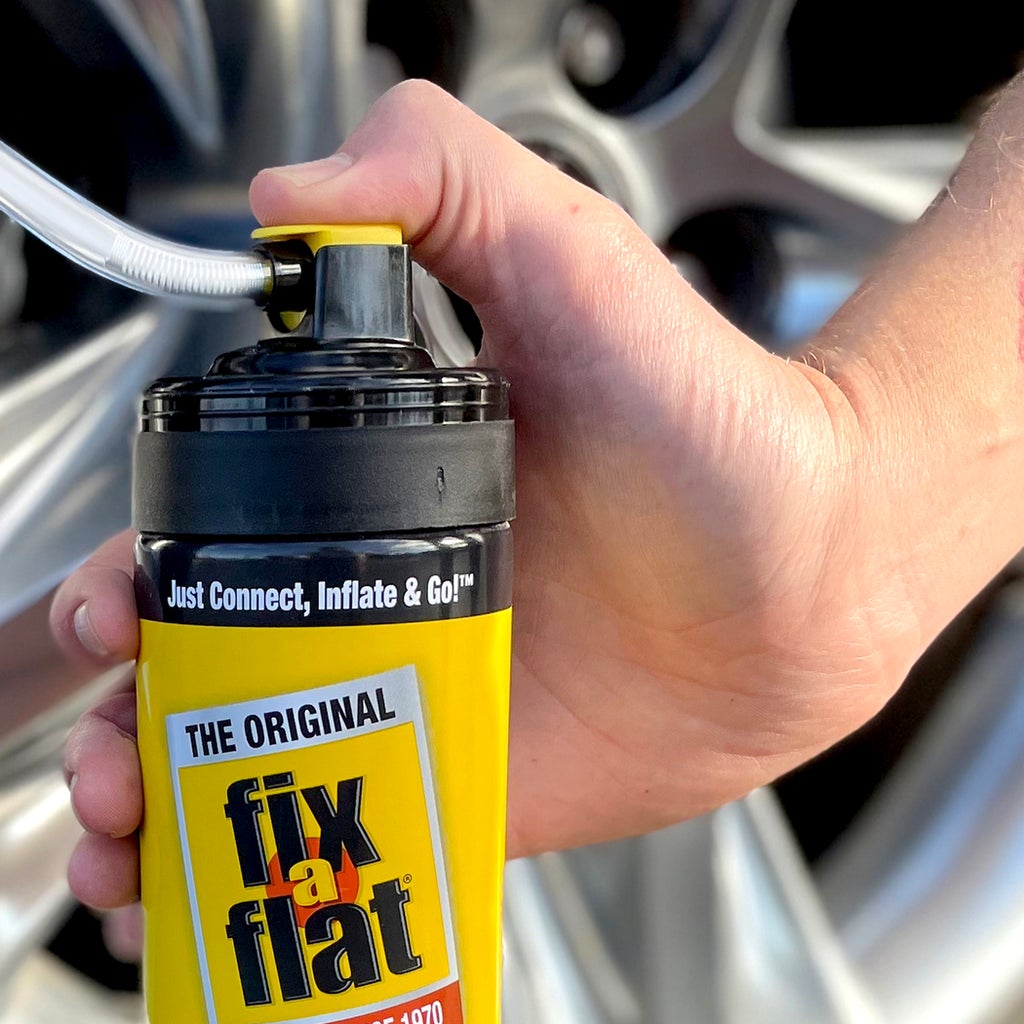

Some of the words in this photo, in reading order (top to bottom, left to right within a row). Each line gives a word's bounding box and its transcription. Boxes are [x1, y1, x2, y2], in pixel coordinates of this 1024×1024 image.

[167, 579, 204, 610] Just
[210, 580, 311, 617] Connect,
[318, 579, 397, 611] Inflate
[404, 576, 421, 606] &
[185, 719, 237, 758] THE
[244, 687, 396, 749] ORIGINAL
[224, 771, 381, 888] fix
[289, 858, 341, 907] a
